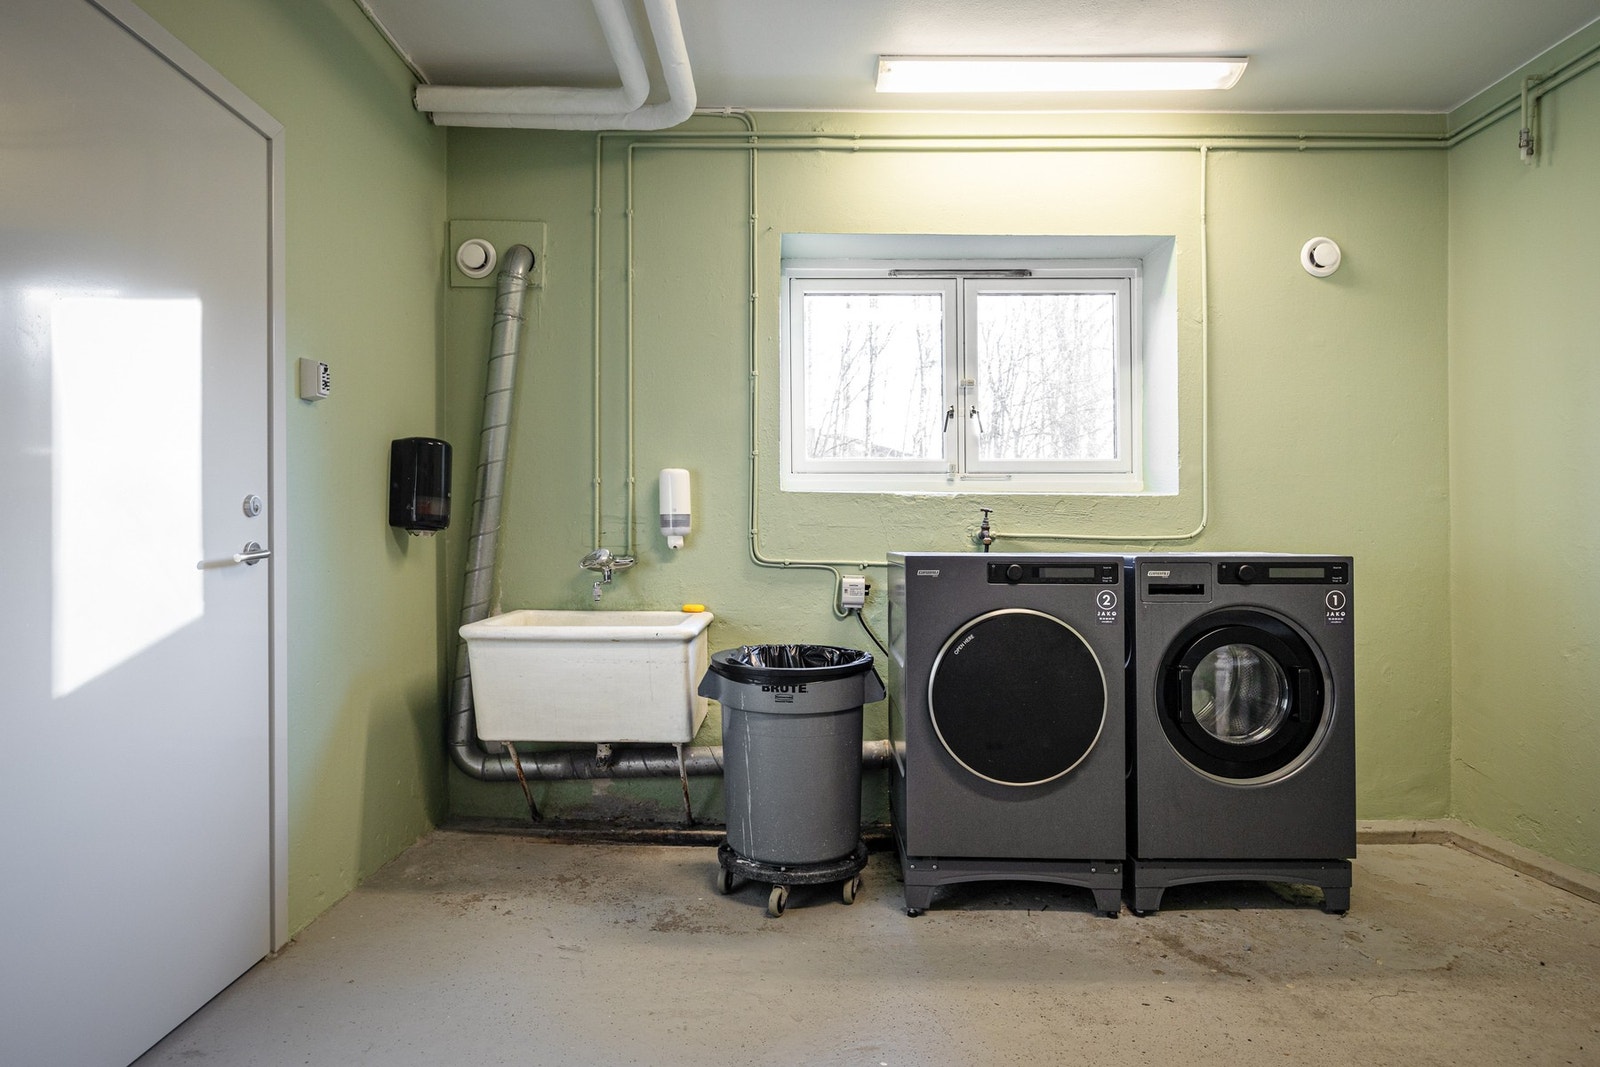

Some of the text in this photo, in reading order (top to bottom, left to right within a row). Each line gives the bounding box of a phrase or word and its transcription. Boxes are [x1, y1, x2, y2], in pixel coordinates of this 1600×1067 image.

[1102, 594, 1111, 606] 2
[953, 634, 975, 655] OPEN HERE
[761, 684, 807, 694] BRUTE
